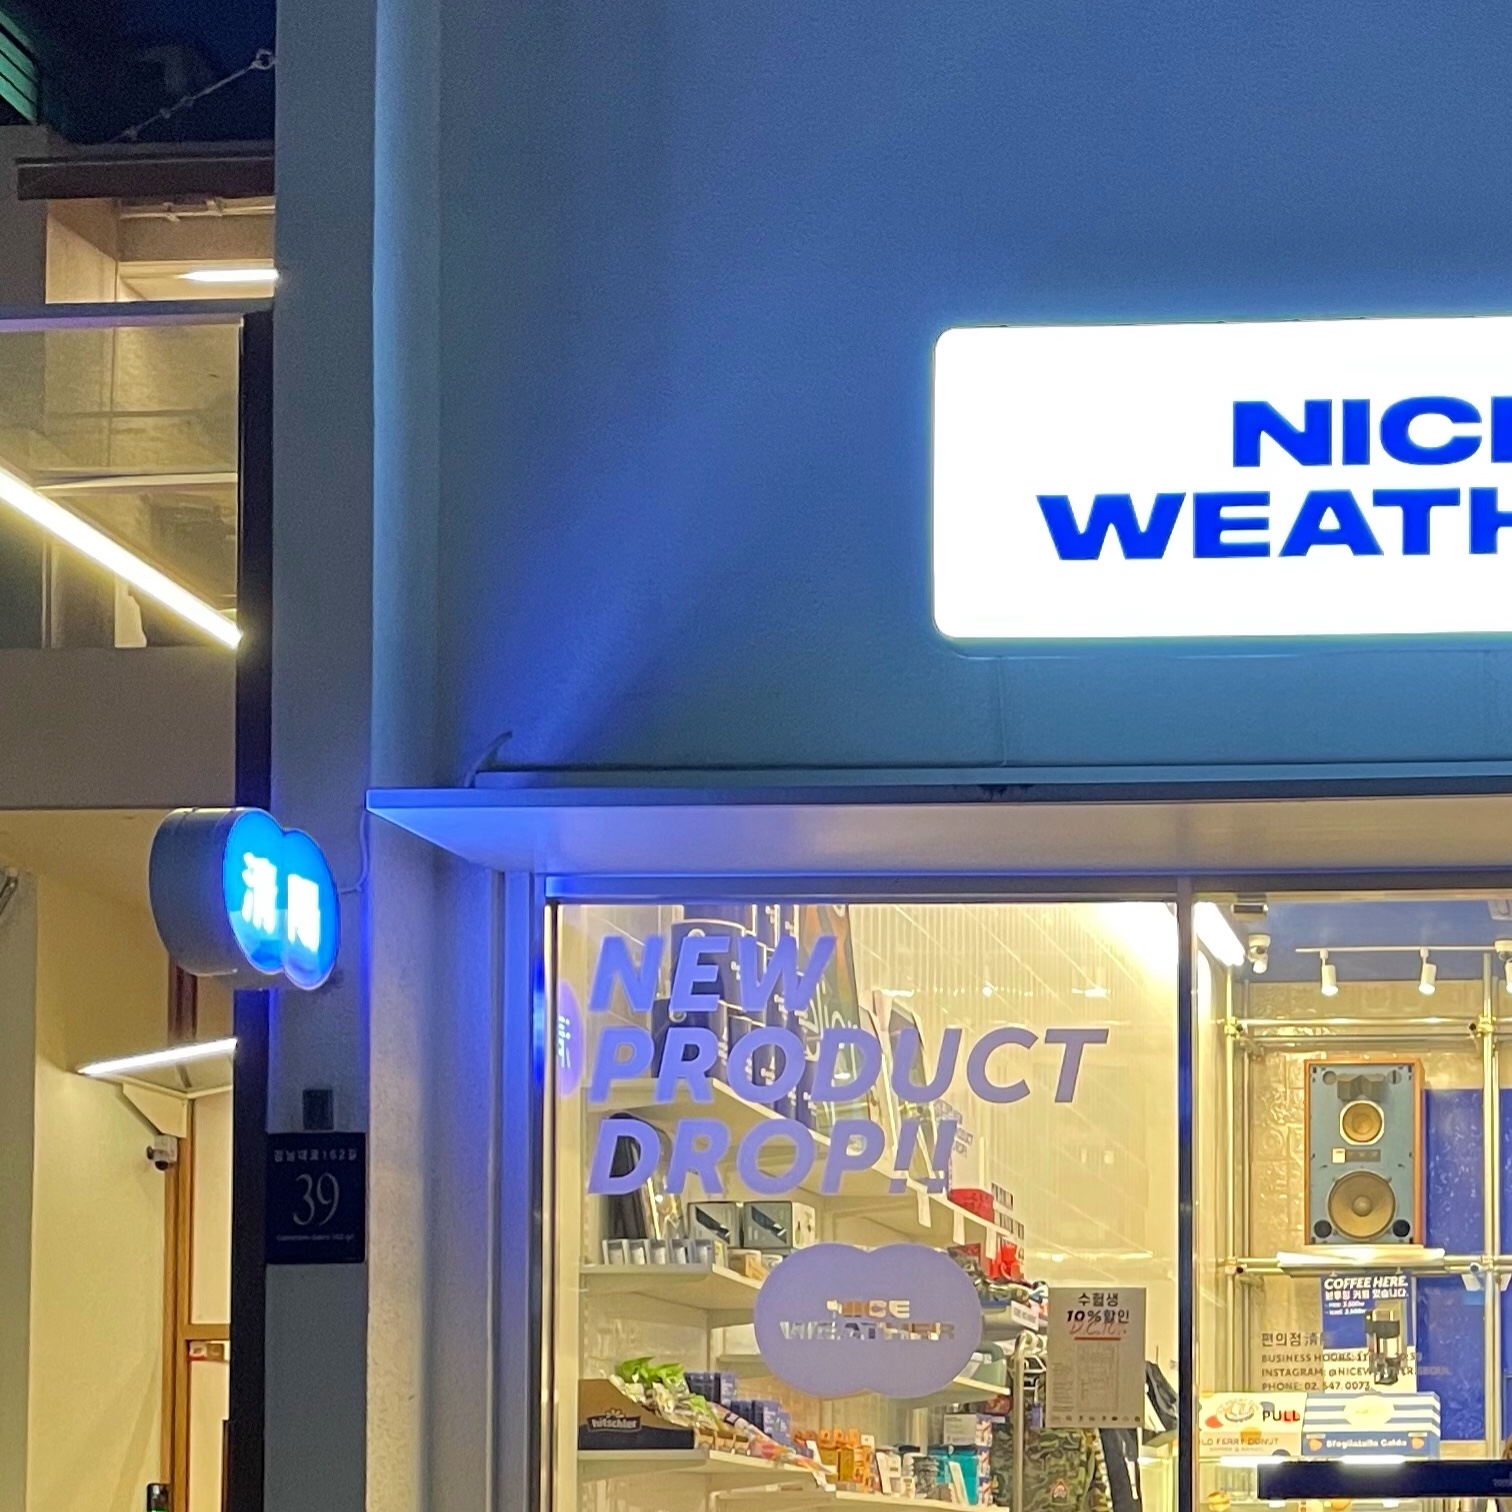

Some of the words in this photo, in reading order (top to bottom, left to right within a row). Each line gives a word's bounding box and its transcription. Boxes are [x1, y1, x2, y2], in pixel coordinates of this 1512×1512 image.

[588, 935, 837, 1013] NEW
[588, 1026, 1110, 1104] PRODUCT
[587, 1118, 958, 1196] DROP!!
[292, 1171, 341, 1226] 39
[1324, 1276, 1372, 1290] COFFEE
[1372, 1275, 1410, 1288] HERE.
[826, 1299, 911, 1319] NICE
[779, 1320, 956, 1341] WEATHER
[1261, 1332, 1302, 1347] 편의점
[1261, 1354, 1312, 1363] BUSINESS
[1261, 1367, 1326, 1377] INSTAGRAM:
[1262, 1409, 1301, 1422] PULL
